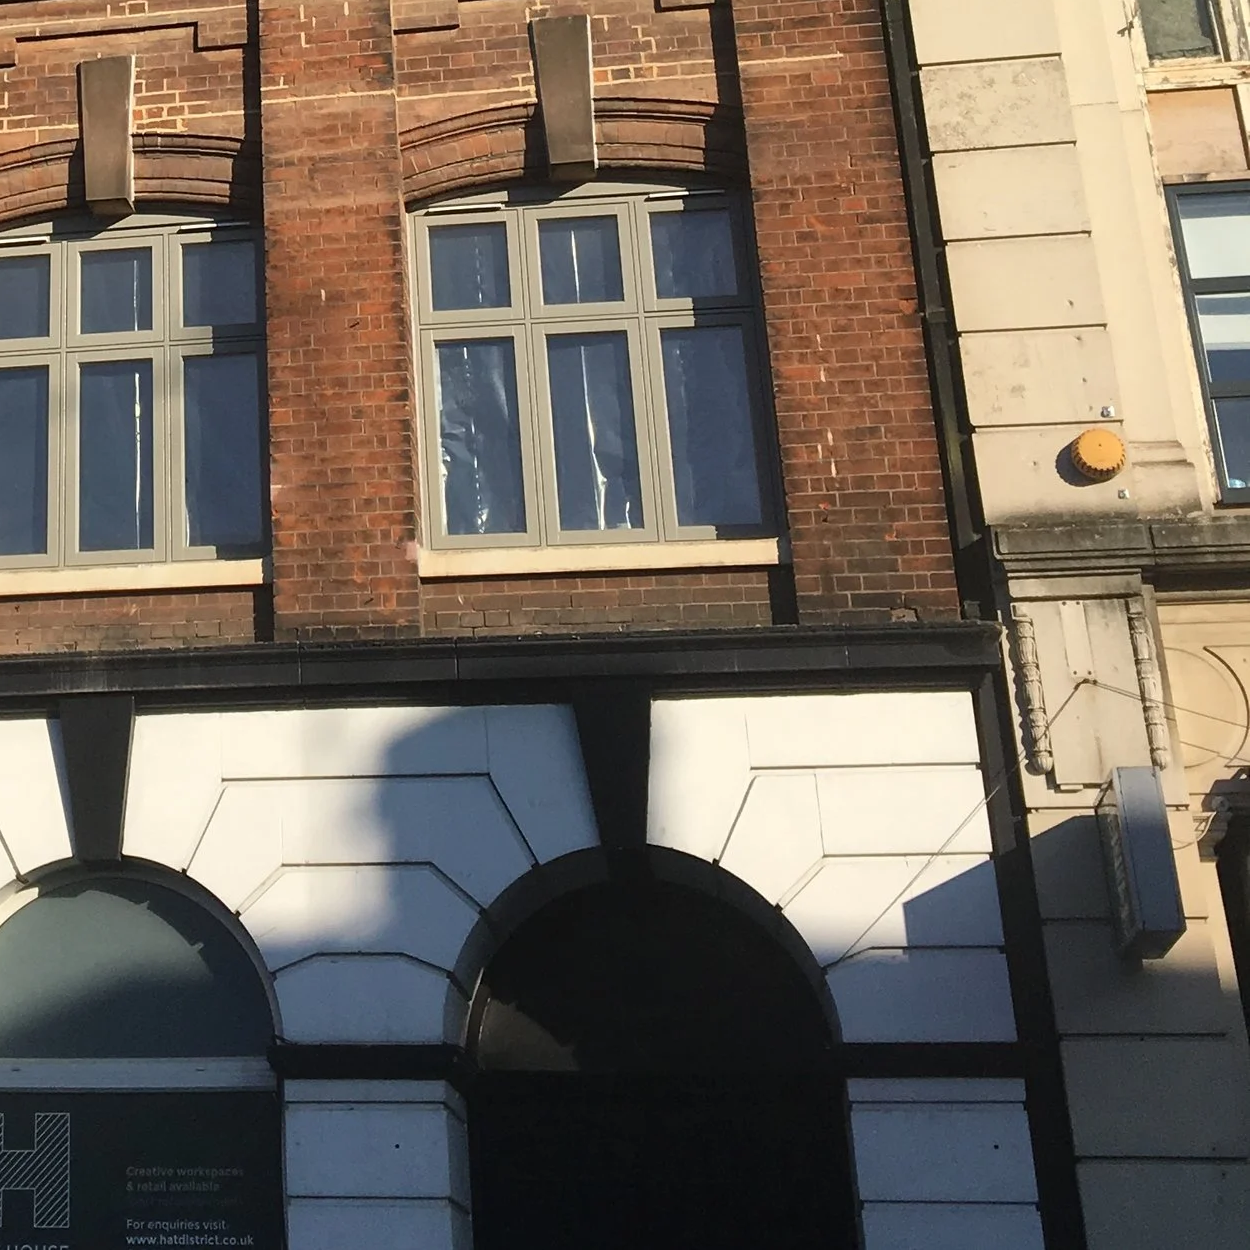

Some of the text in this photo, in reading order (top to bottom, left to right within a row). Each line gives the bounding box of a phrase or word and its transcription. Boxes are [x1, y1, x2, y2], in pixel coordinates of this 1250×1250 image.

[126, 1166, 244, 1179] Creative workspaces
[126, 1180, 220, 1191] & retail available
[126, 1219, 145, 1230] For
[147, 1218, 200, 1232] enquiries
[126, 1234, 254, 1246] www.hatdistrict.co.uk
